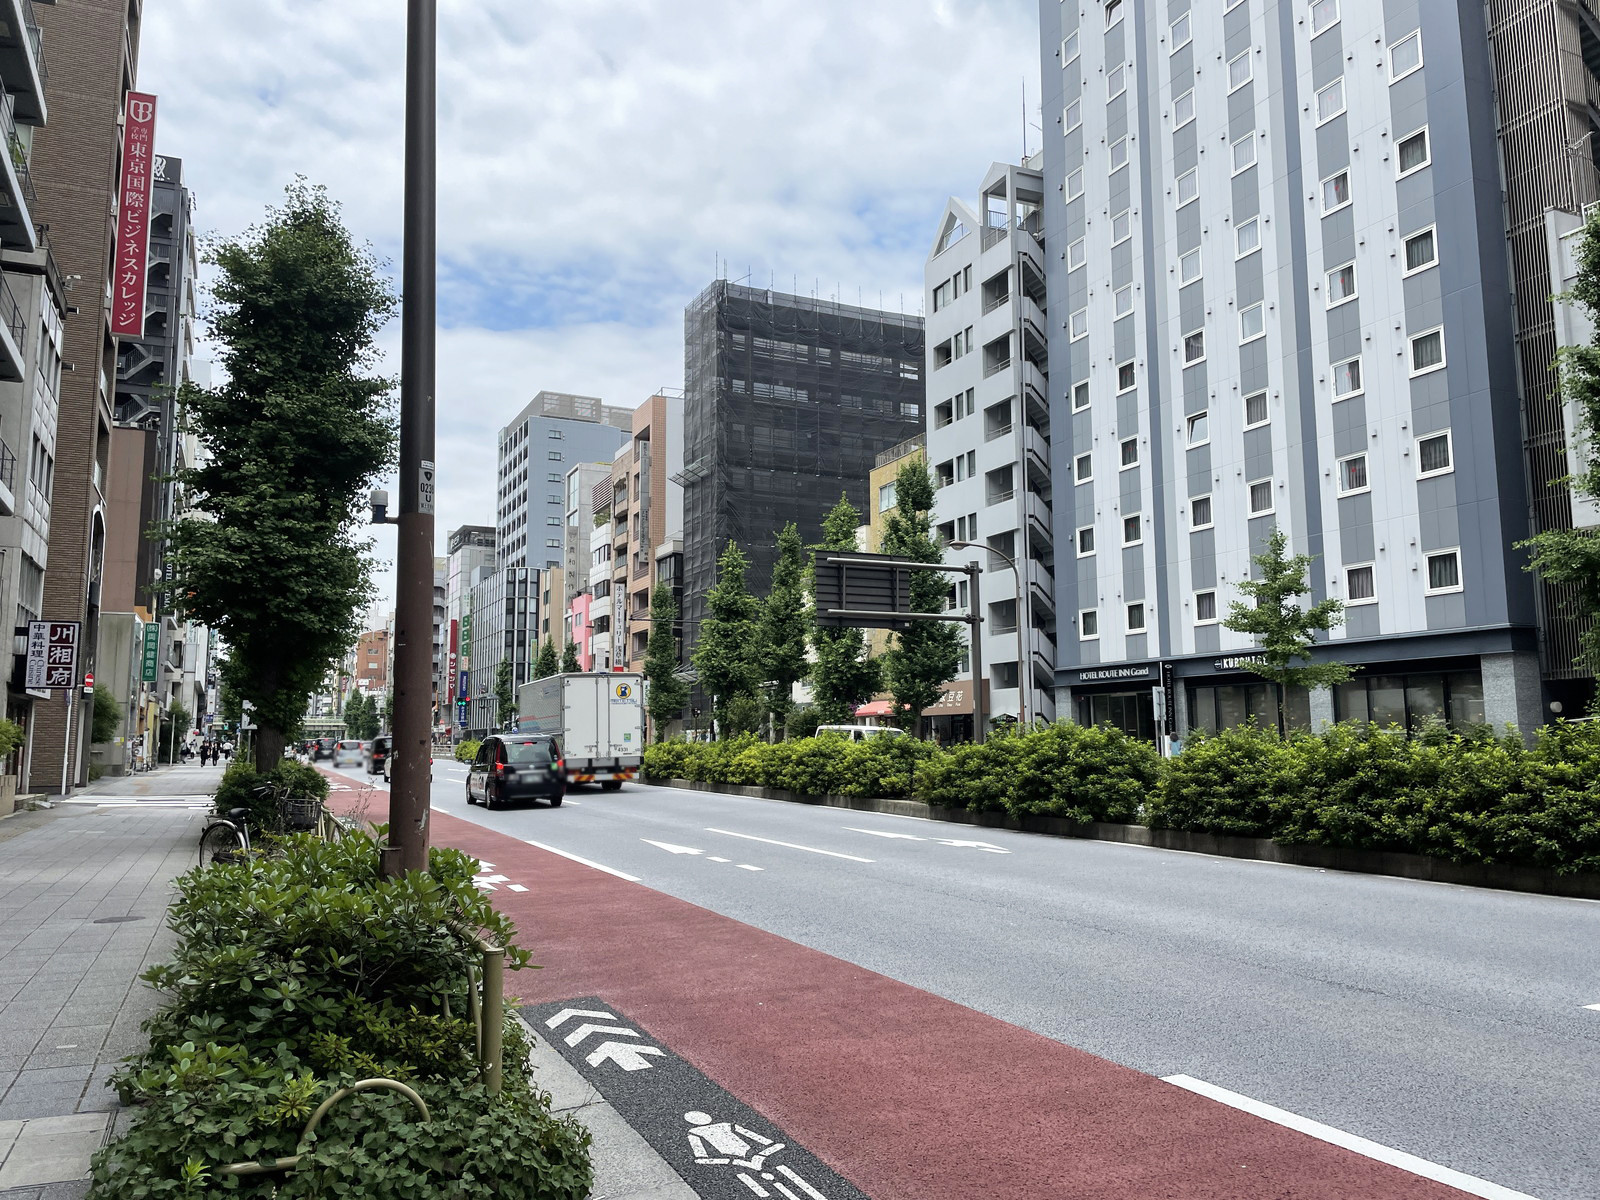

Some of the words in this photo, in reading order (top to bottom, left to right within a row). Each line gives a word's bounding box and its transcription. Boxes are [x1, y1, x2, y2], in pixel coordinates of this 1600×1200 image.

[118, 141, 147, 326] 東京国際ビジネスカレッジ
[30, 624, 45, 658] 中華料理
[46, 626, 74, 685] 川湘府
[1079, 671, 1098, 680] HOTEL
[1099, 670, 1118, 679] ROUTE
[1118, 668, 1130, 677] INN
[1130, 667, 1149, 676] Grand
